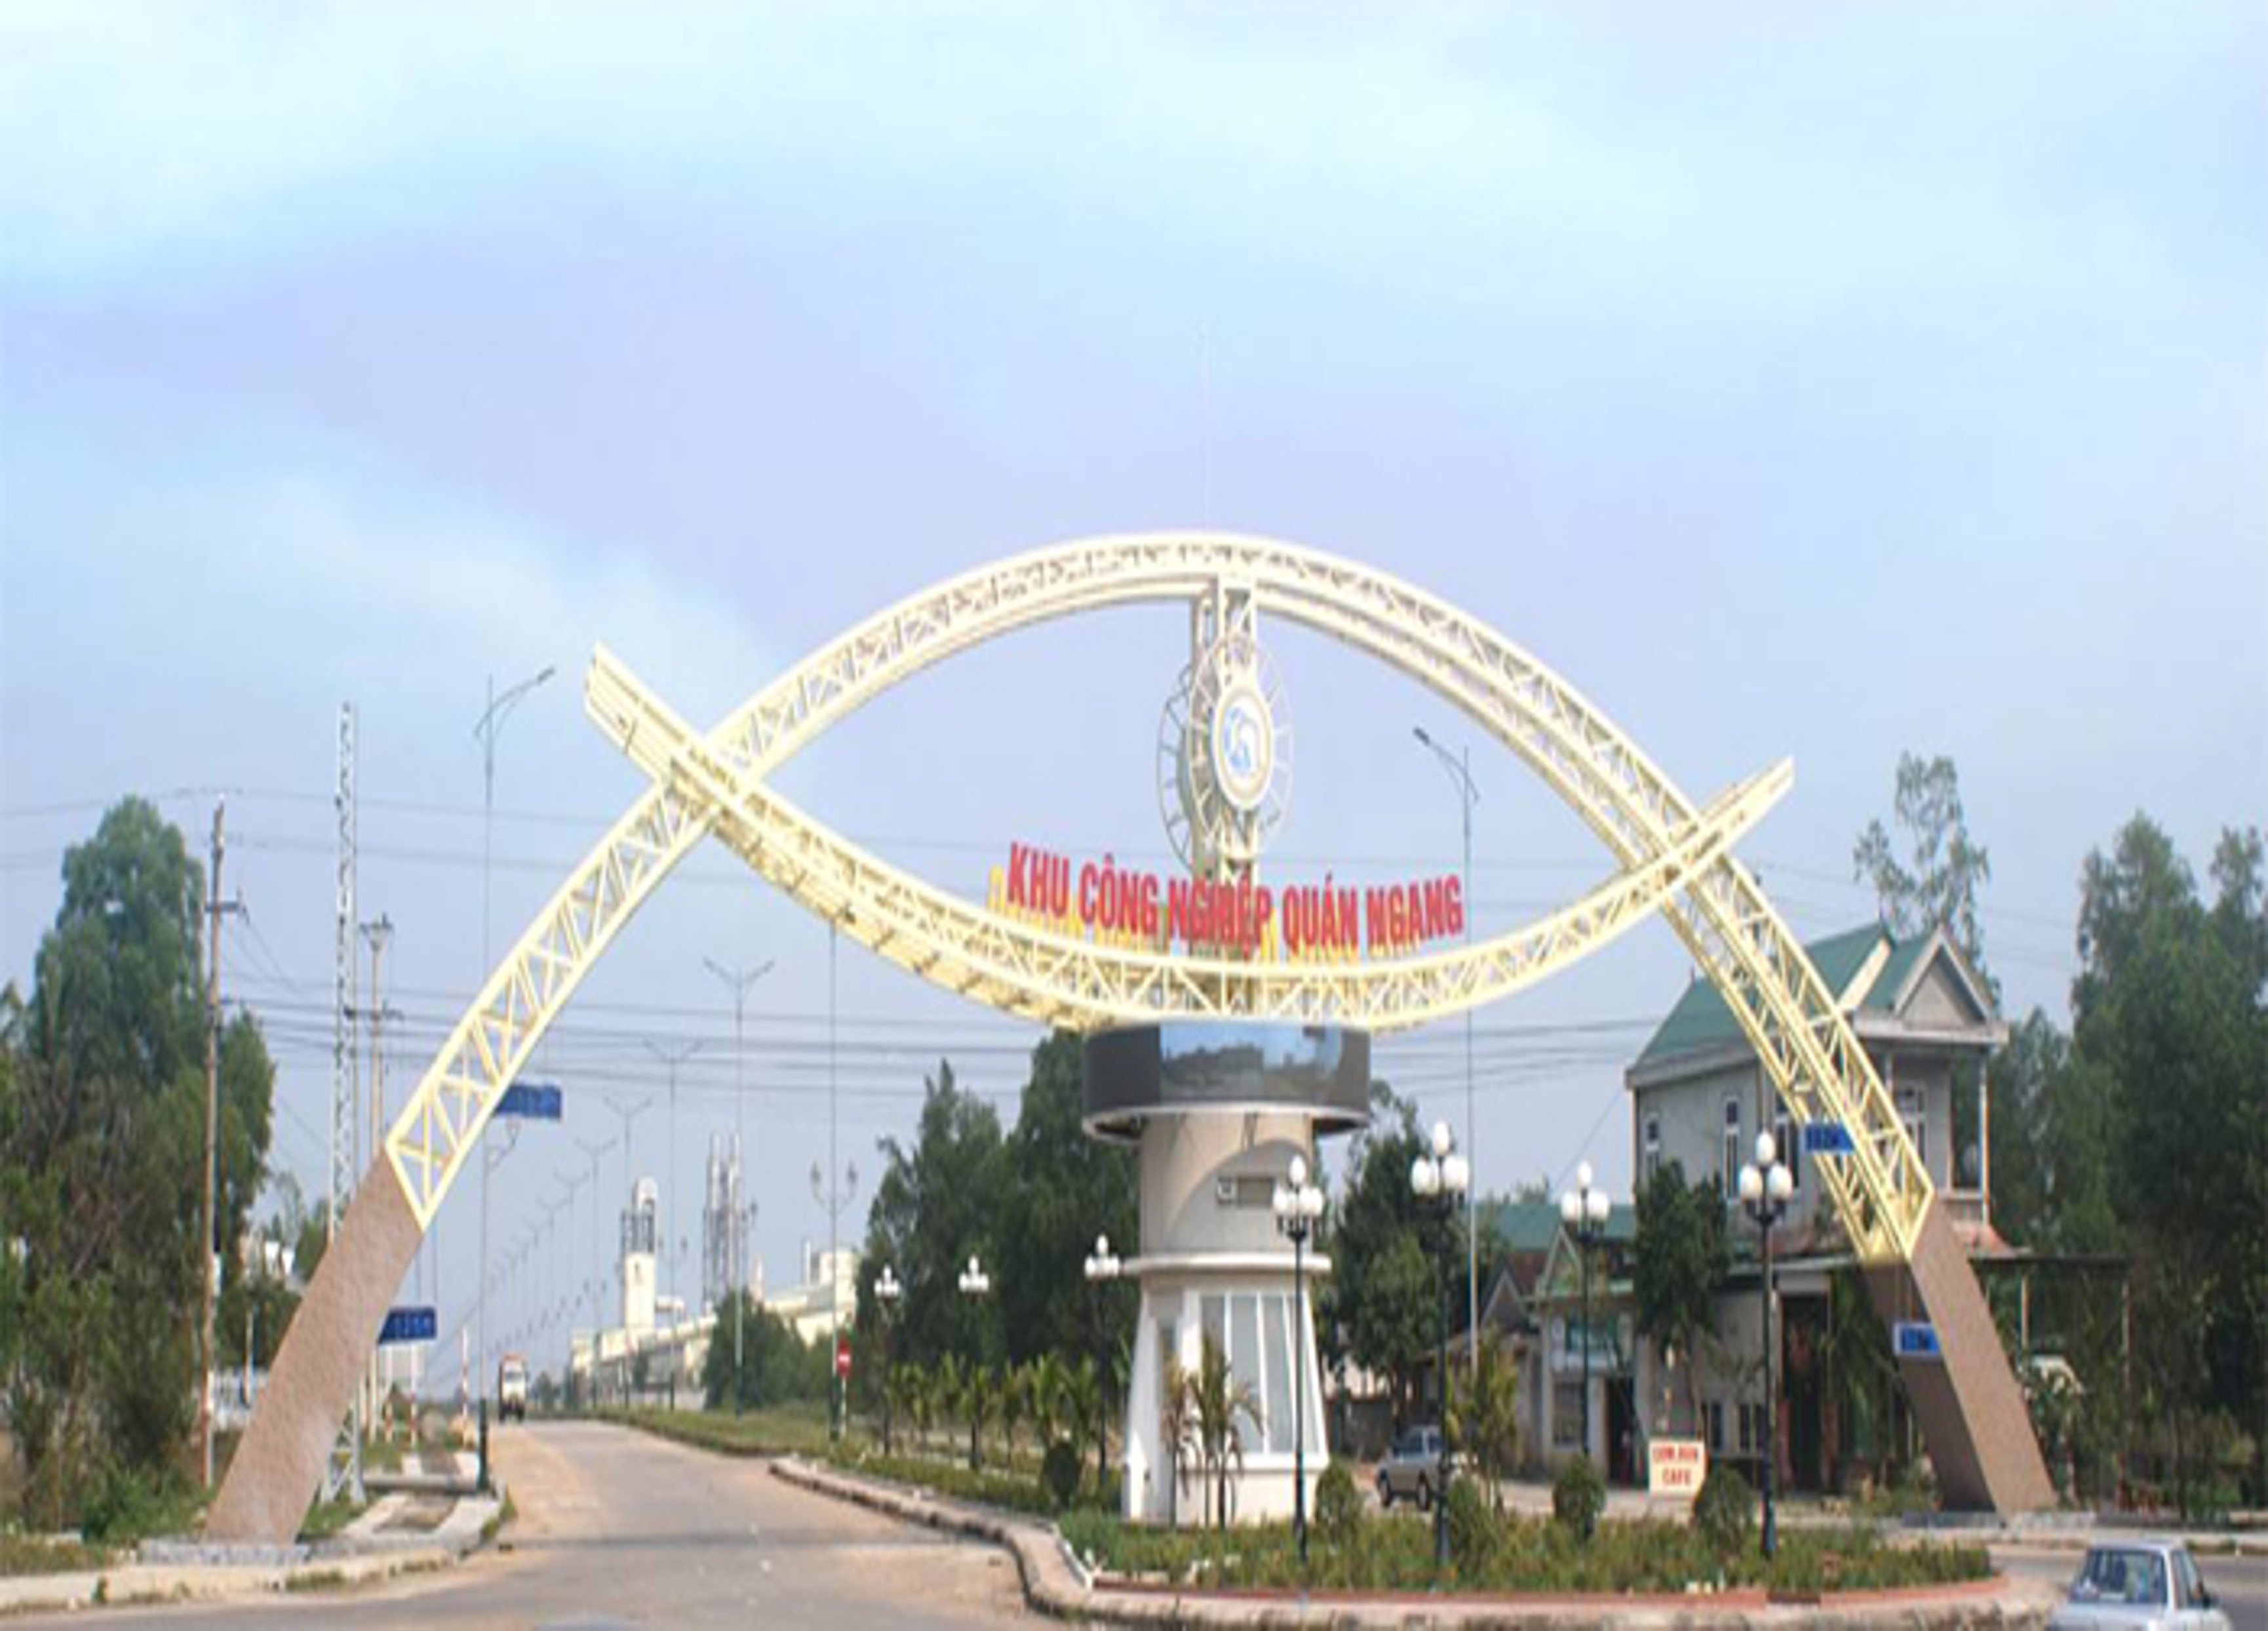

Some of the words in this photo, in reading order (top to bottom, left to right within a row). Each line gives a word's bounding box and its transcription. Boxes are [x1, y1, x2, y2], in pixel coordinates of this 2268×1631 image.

[1007, 840, 1069, 917] KHU
[1079, 852, 1158, 933] CÔNG
[1167, 871, 1272, 956] NGHIỆP
[1282, 871, 1358, 951] QUÁN
[1367, 874, 1463, 946] NGANG
